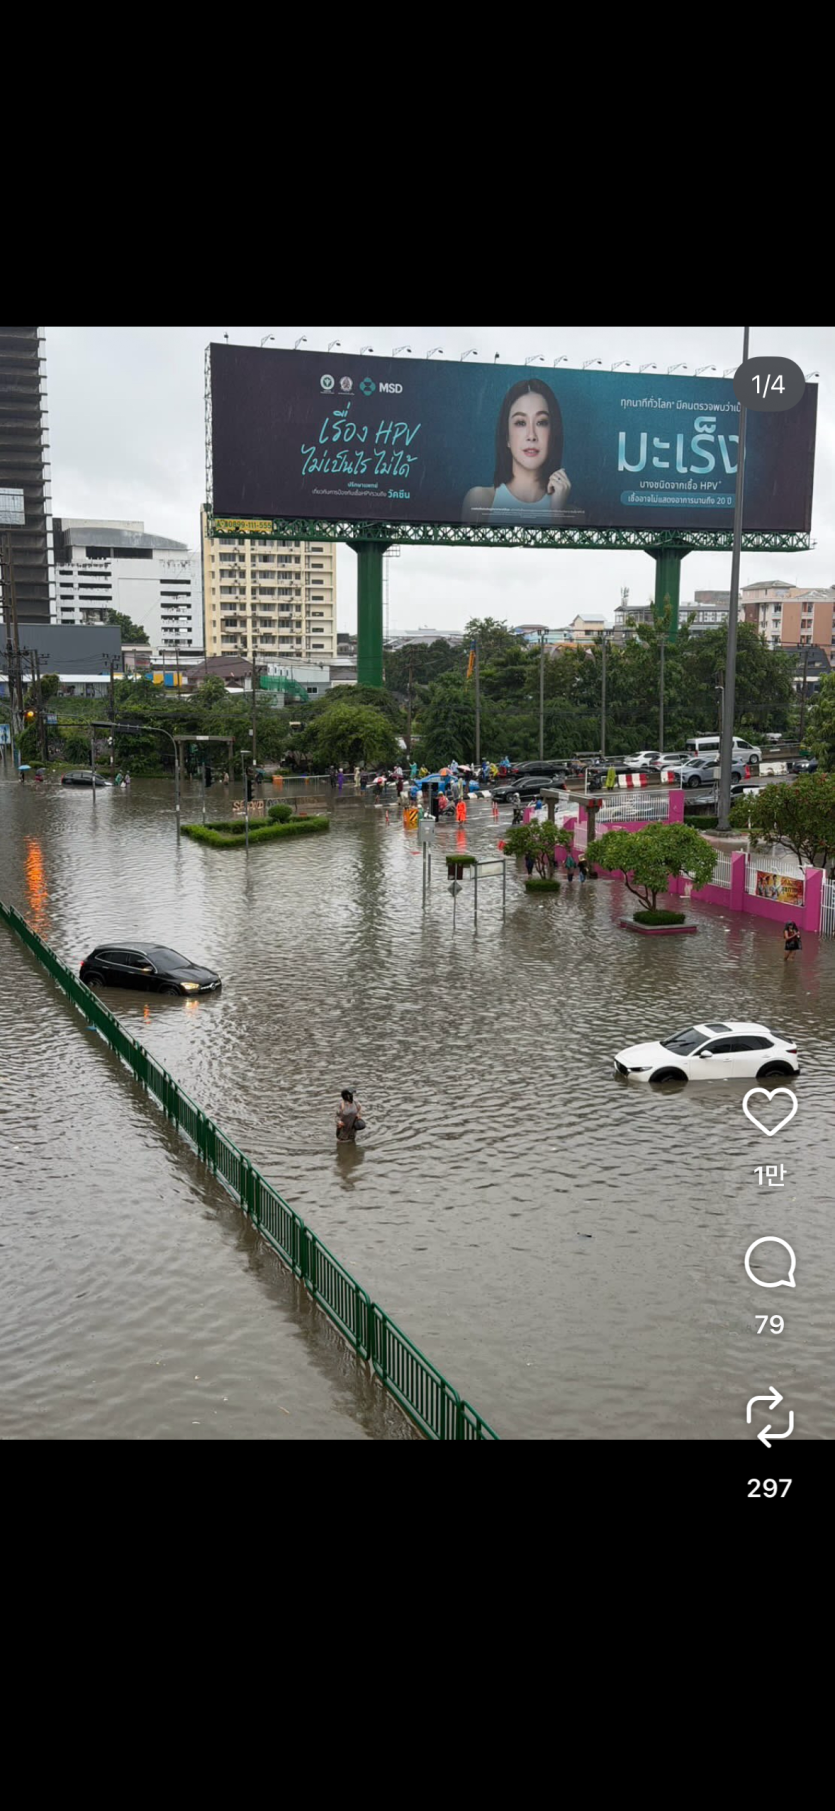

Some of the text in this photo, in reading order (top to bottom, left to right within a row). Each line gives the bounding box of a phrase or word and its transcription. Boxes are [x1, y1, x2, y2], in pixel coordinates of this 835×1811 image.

[379, 382, 403, 394] MSD
[676, 400, 741, 412] มีคนตรวจพบว่าเป็
[319, 401, 421, 447] เรื่อง HPV
[618, 416, 746, 474] มะเร็ง
[301, 444, 418, 477] ไม่เป็นไร ไม่ได้
[639, 478, 698, 490] บางชนิดจากเชื้อ
[387, 489, 411, 499] วัคซีน
[716, 496, 726, 505] 20
